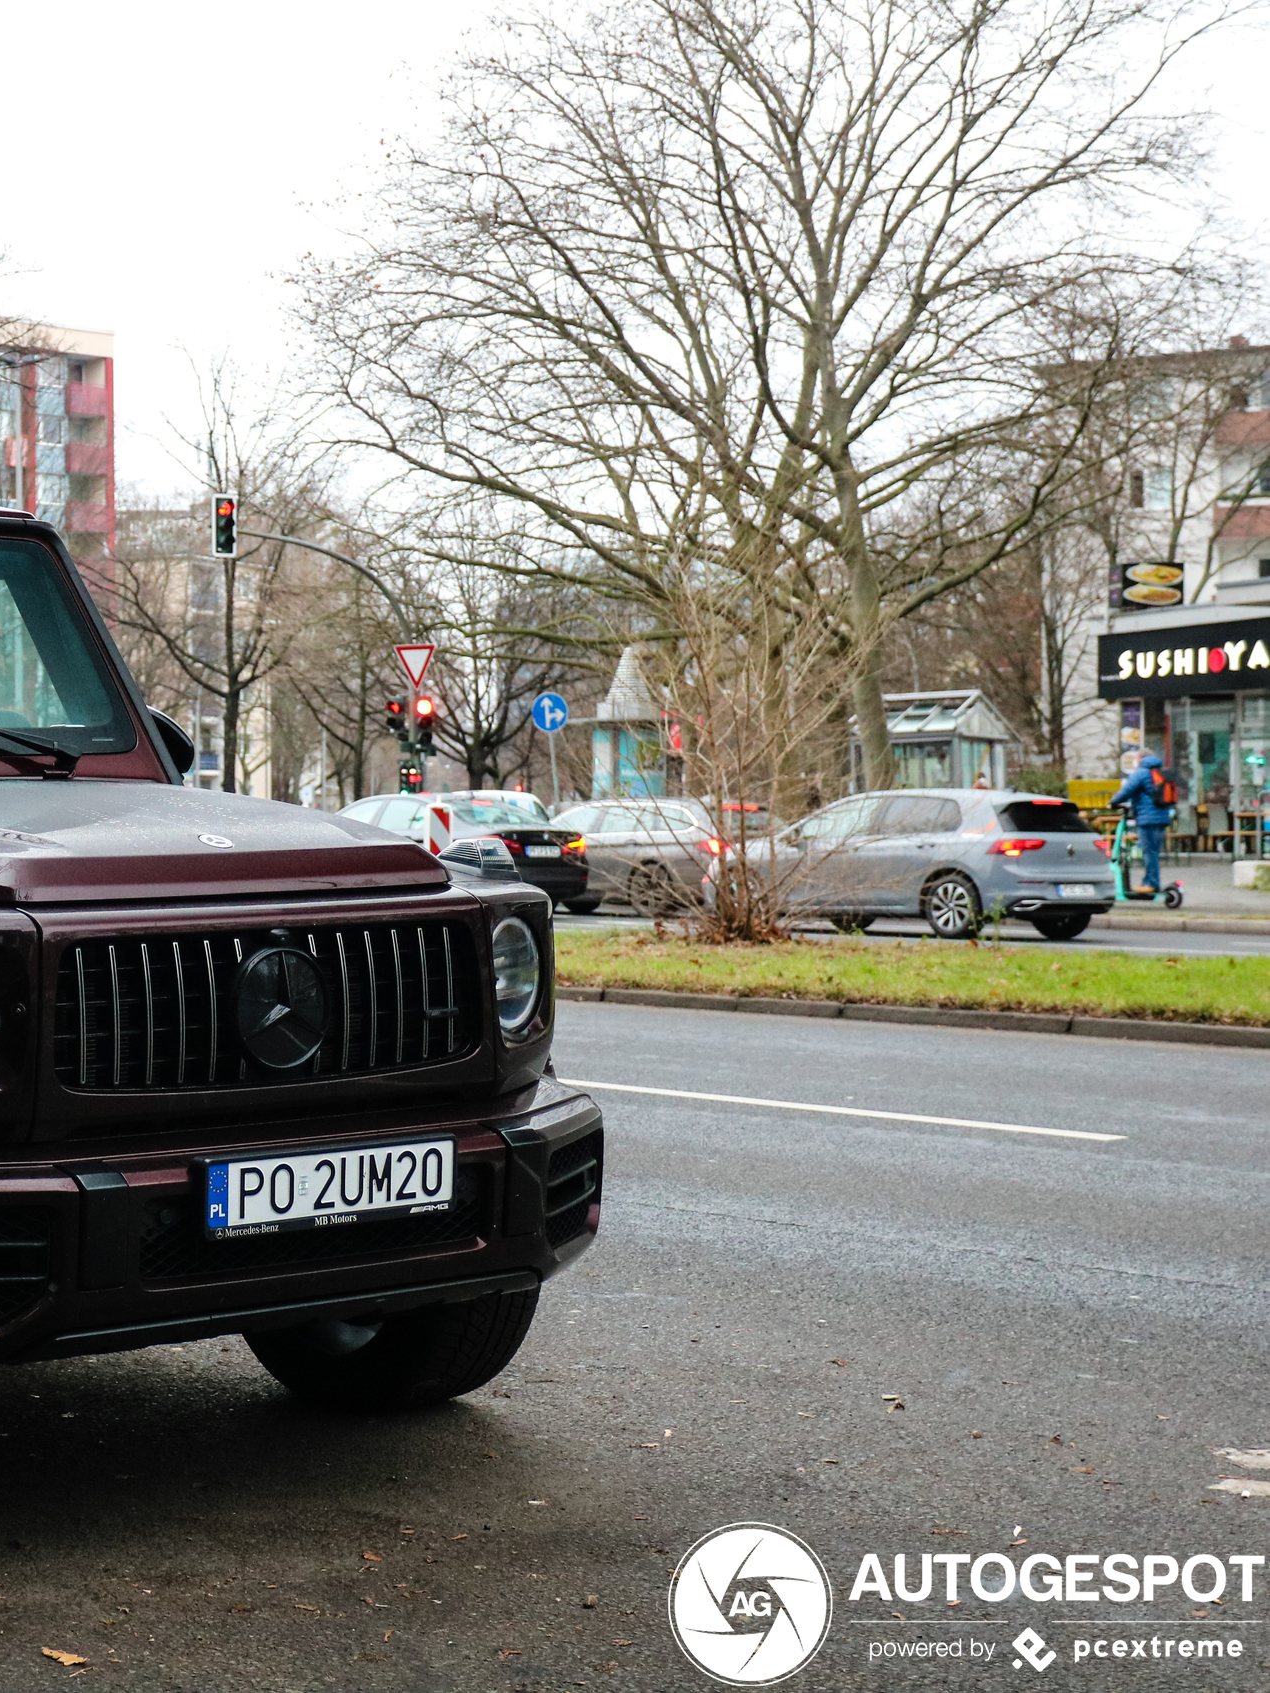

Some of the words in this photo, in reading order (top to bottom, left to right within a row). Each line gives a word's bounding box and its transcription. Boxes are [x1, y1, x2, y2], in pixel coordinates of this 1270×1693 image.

[239, 1163, 295, 1219] PO
[313, 1147, 443, 1210] 2UM20
[210, 1203, 225, 1219] PL
[423, 1202, 449, 1212] AMG
[314, 1215, 328, 1226] MB
[330, 1213, 357, 1225] Motors
[224, 1224, 279, 1238] Mercedes-Benz
